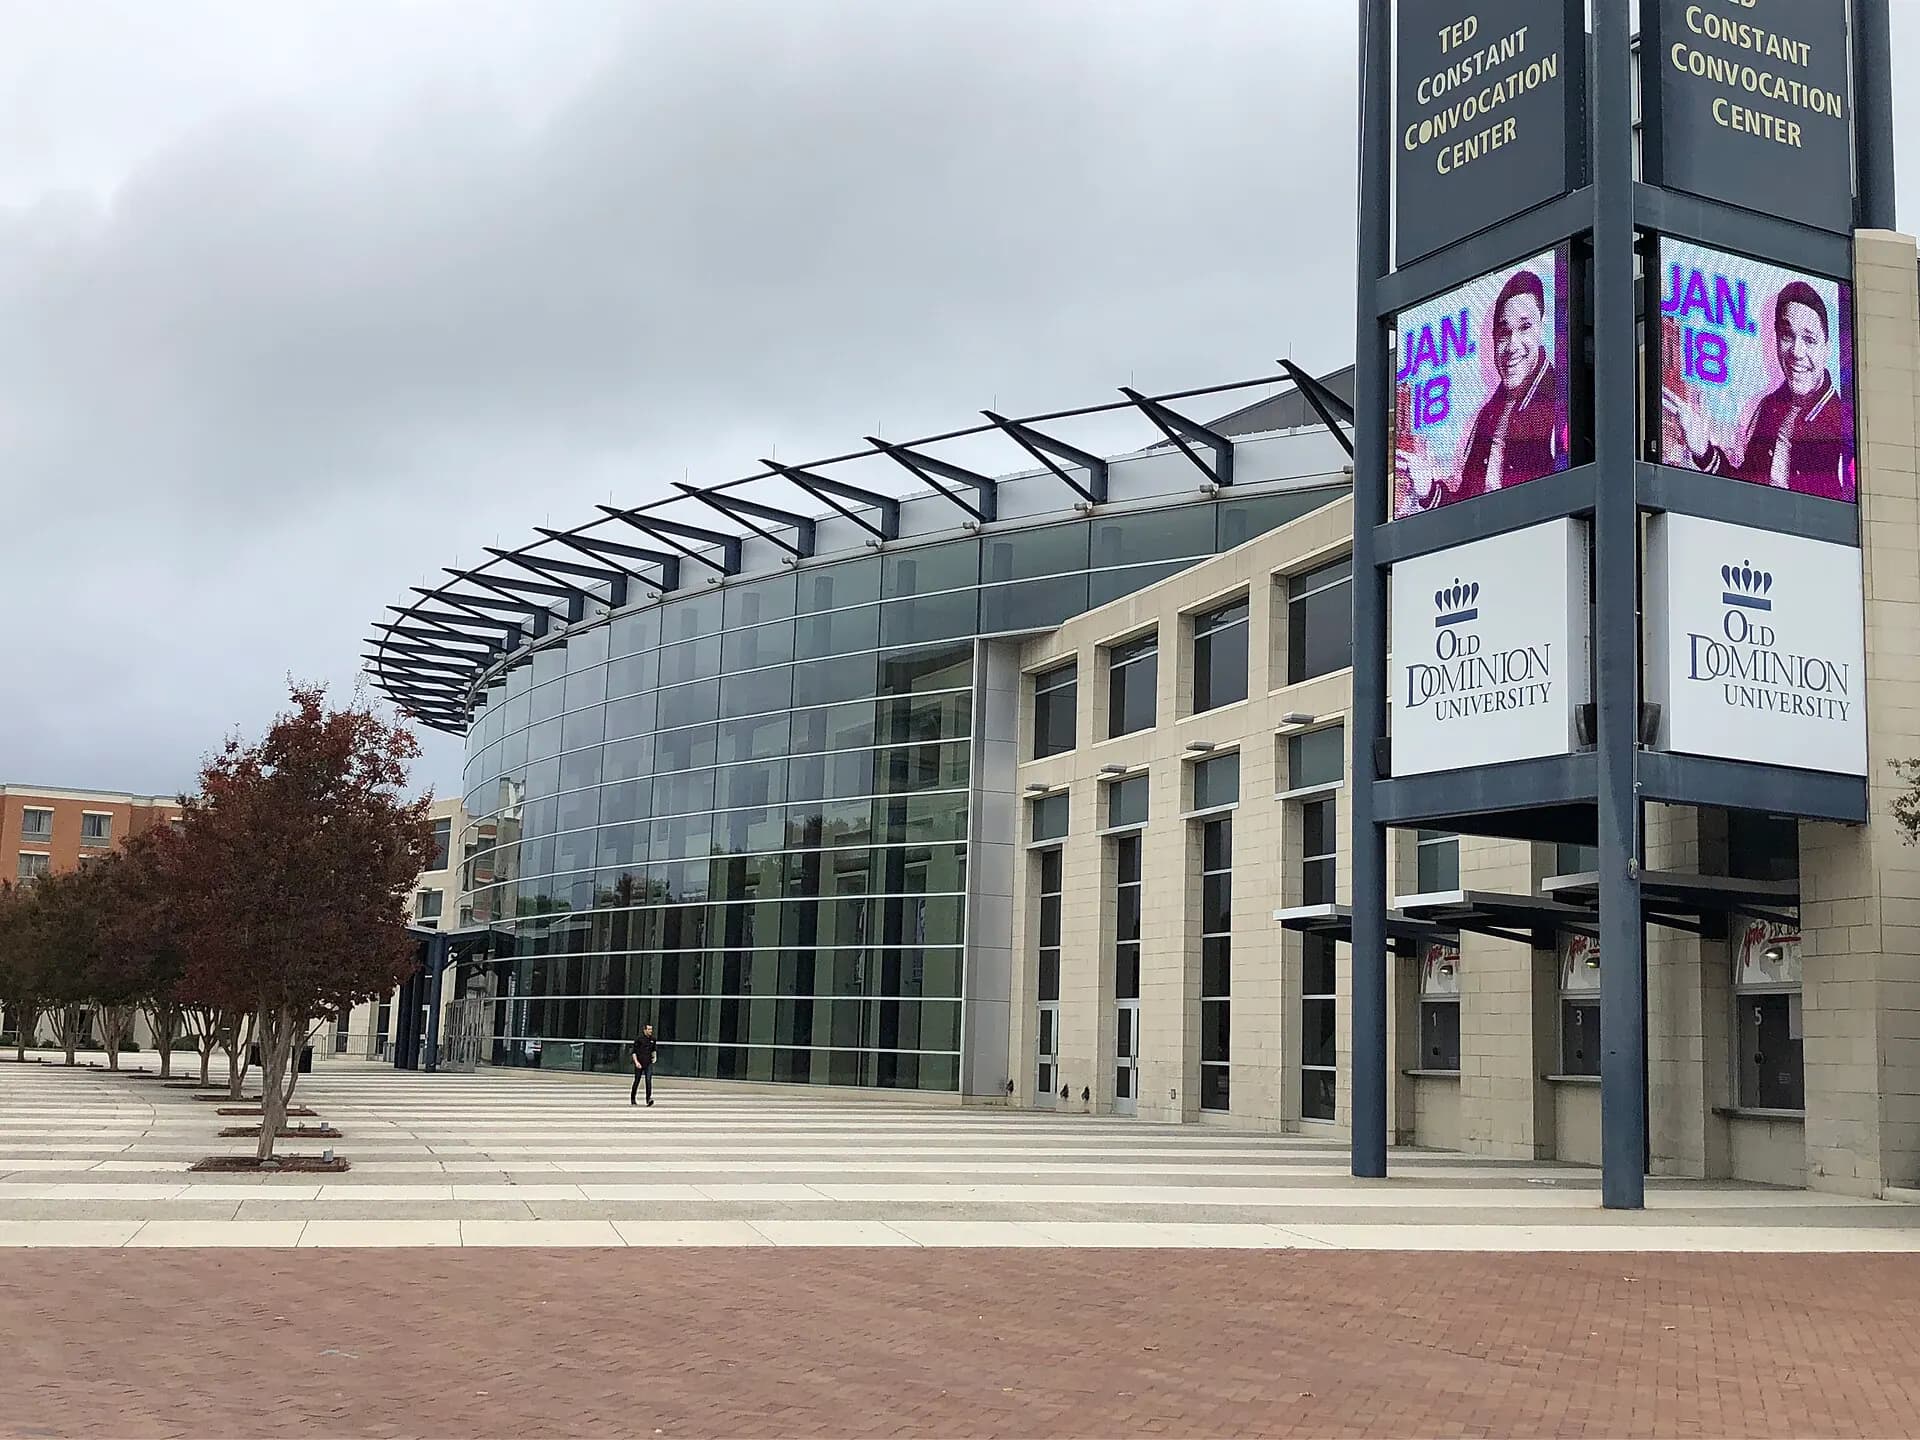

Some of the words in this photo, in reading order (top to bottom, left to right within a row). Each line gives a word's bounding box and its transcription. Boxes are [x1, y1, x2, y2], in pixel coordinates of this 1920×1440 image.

[1438, 15, 1478, 54] TED
[1685, 5, 1811, 68] CONSTANT
[1417, 25, 1528, 105] CONSTANT
[1671, 42, 1842, 119] CONVOCATION
[1404, 52, 1557, 151] CONVOCATION
[1712, 97, 1802, 148] CENTER
[1437, 117, 1517, 175] CENTER
[1661, 264, 1757, 334] JAN.
[1396, 310, 1477, 381] JAN.
[1683, 328, 1729, 384] 18
[1414, 375, 1451, 431] 18
[1435, 629, 1481, 661] OLD
[1723, 609, 1775, 647] OLD
[1405, 643, 1552, 709] DOMINION
[1686, 632, 1849, 696] DOMINION
[1435, 681, 1552, 721] UNIVERSITY
[1723, 683, 1851, 723] UNIVERSITY
[1432, 1011, 1437, 1027] 1
[1576, 1009, 1583, 1025] 3
[1754, 1007, 1763, 1026] 5
